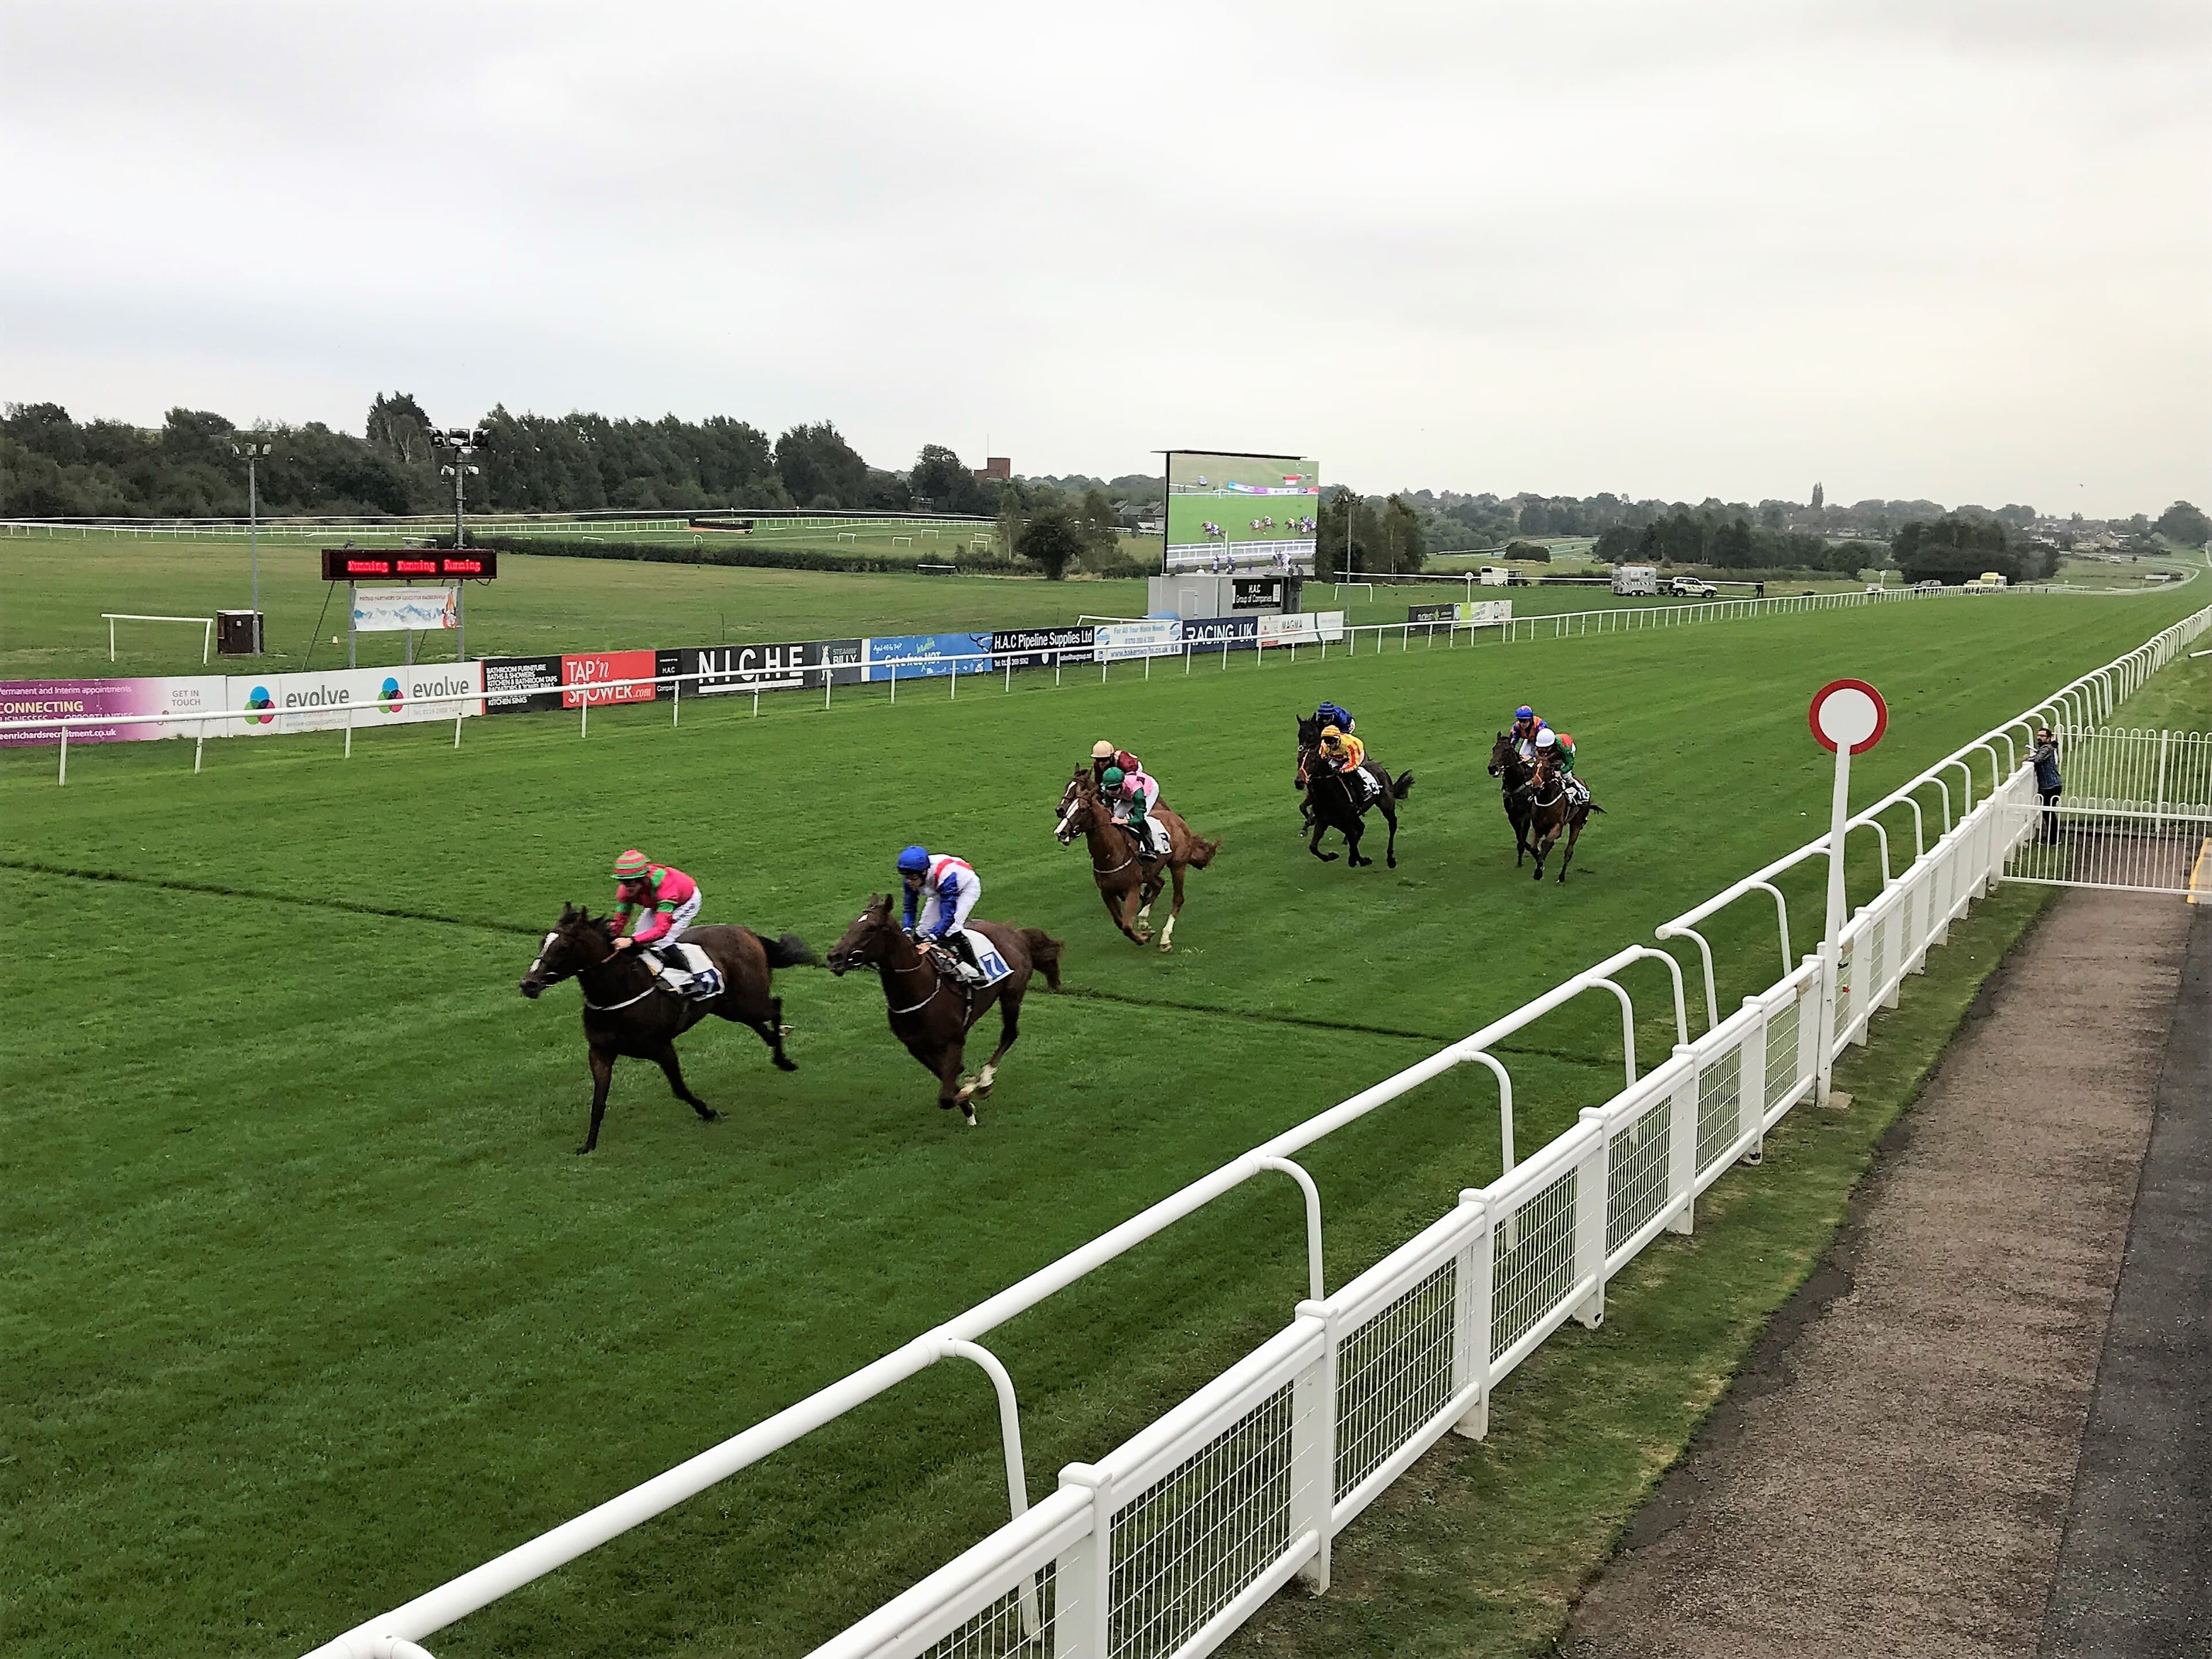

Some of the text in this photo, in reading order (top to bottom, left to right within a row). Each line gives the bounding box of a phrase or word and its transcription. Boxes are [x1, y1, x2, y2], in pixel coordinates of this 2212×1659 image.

[347, 559, 481, 573] Running Running Running
[994, 634, 1017, 649] H.A.C
[1018, 633, 1048, 650] Pipeline
[1049, 631, 1080, 647] Supplies
[1081, 629, 1093, 643] Ltd
[1186, 623, 1255, 646] RACING UK
[486, 664, 547, 674] BATHROOM FURNITURE
[699, 646, 804, 684] NICHE
[509, 671, 536, 679] SHOWERS
[515, 676, 544, 684] BATHROOM
[82, 685, 132, 695] appointments
[412, 676, 469, 698] evolve
[172, 698, 201, 706] TOUCH
[286, 684, 349, 707] evolve
[488, 698, 512, 706] KITCHEN
[0, 700, 84, 714] CONNECTING
[982, 953, 1003, 975] 7
